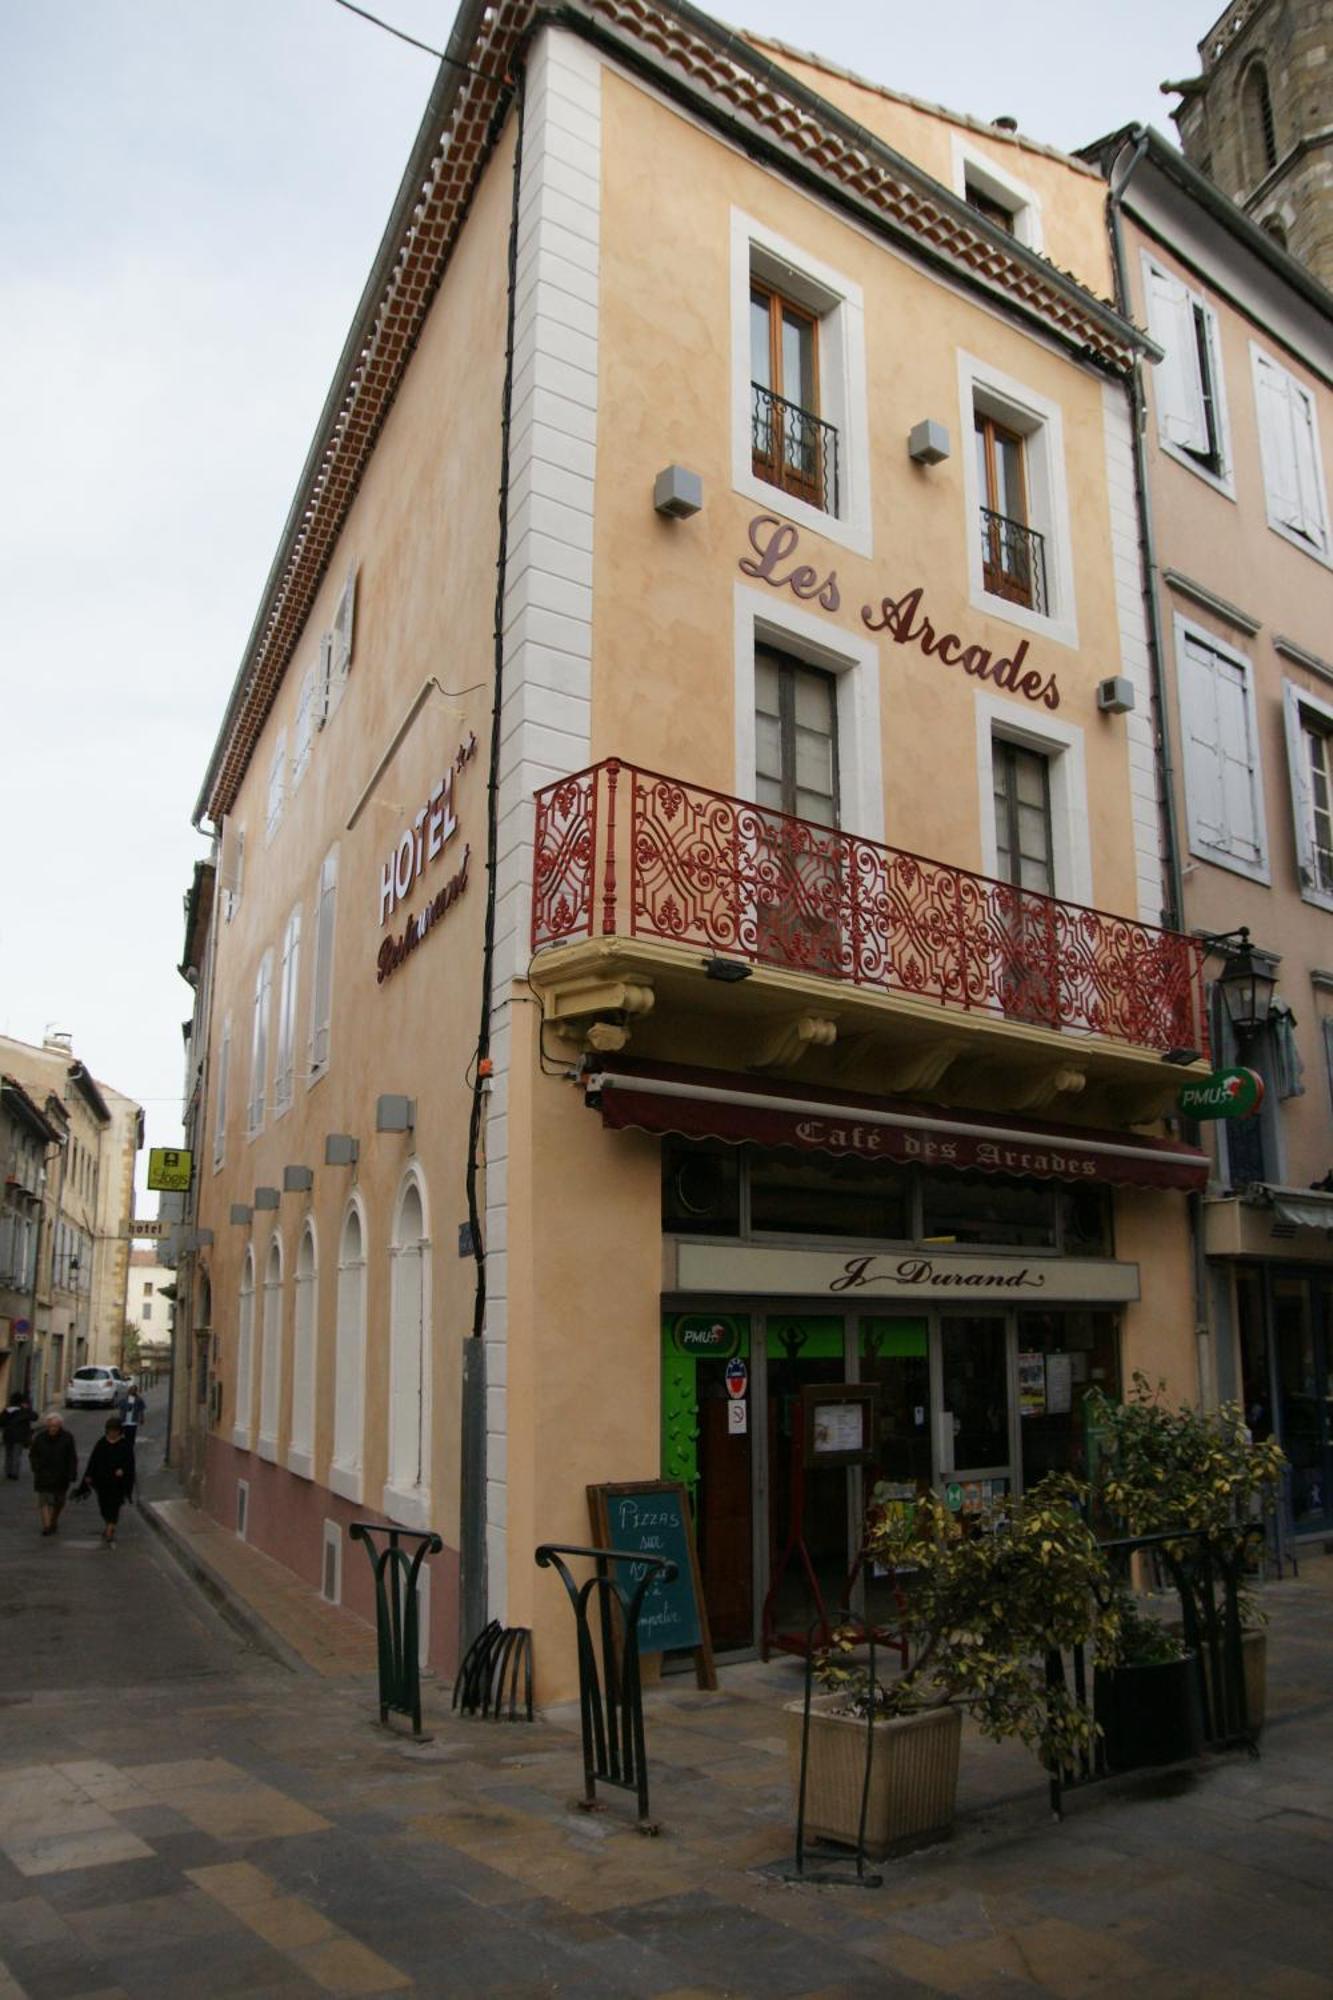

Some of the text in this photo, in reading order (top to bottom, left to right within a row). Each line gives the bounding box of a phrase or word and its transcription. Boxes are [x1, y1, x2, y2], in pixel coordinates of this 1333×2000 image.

[739, 514, 1061, 710] Les Arcades
[380, 767, 458, 928] HOTEL
[1183, 1087, 1220, 1107] PMU
[795, 1121, 1097, 1175] Café des Arcades
[128, 1222, 162, 1235] hotel
[897, 1259, 1044, 1287] Durand
[684, 1329, 711, 1344] PMU
